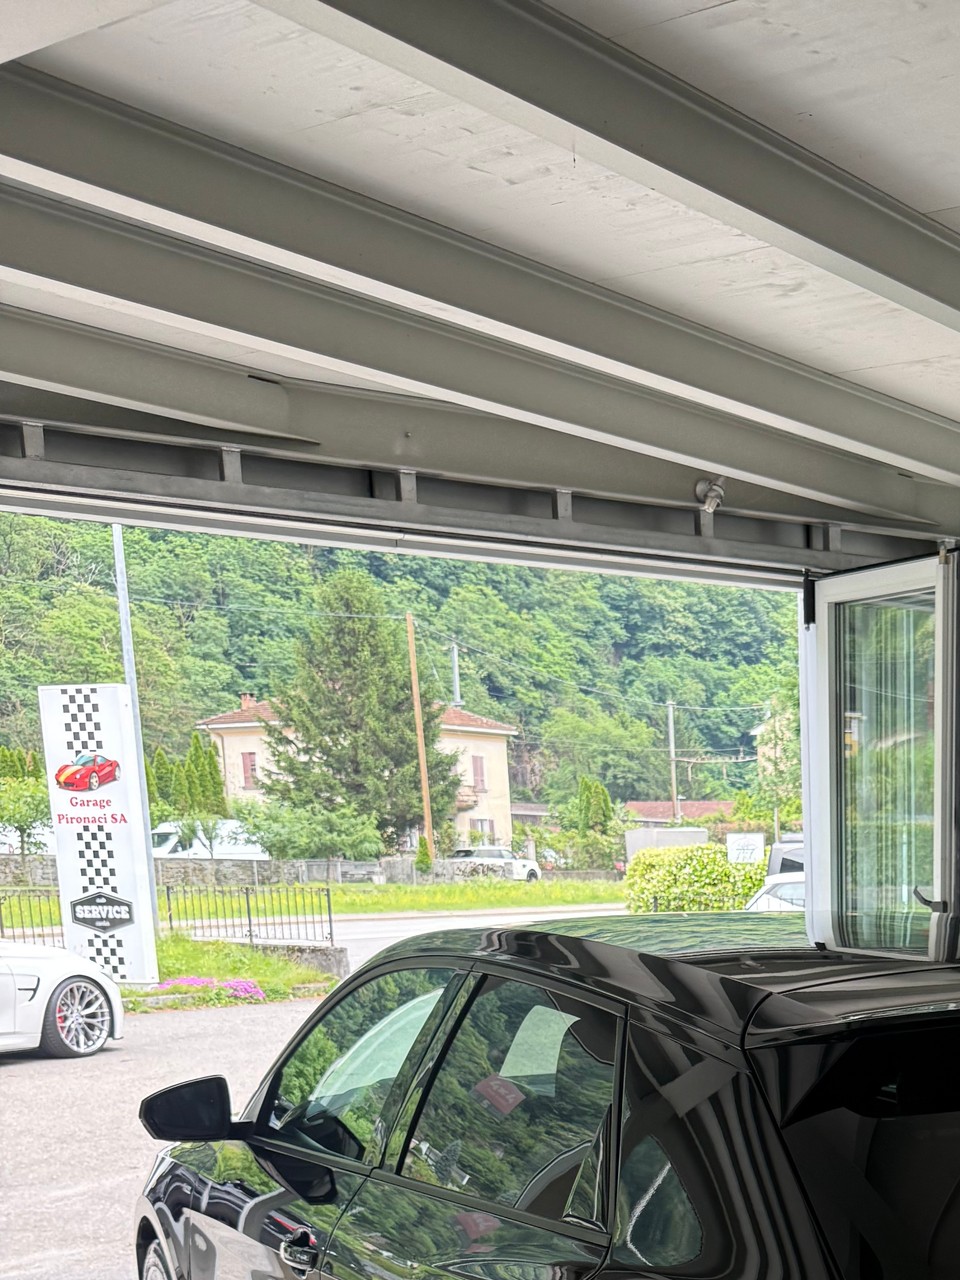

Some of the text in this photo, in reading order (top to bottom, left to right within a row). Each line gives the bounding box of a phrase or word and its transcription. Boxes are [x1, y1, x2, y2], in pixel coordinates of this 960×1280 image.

[69, 797, 112, 809] Garage
[57, 813, 128, 824] Pironaci SA
[75, 905, 130, 919] SERVICE
